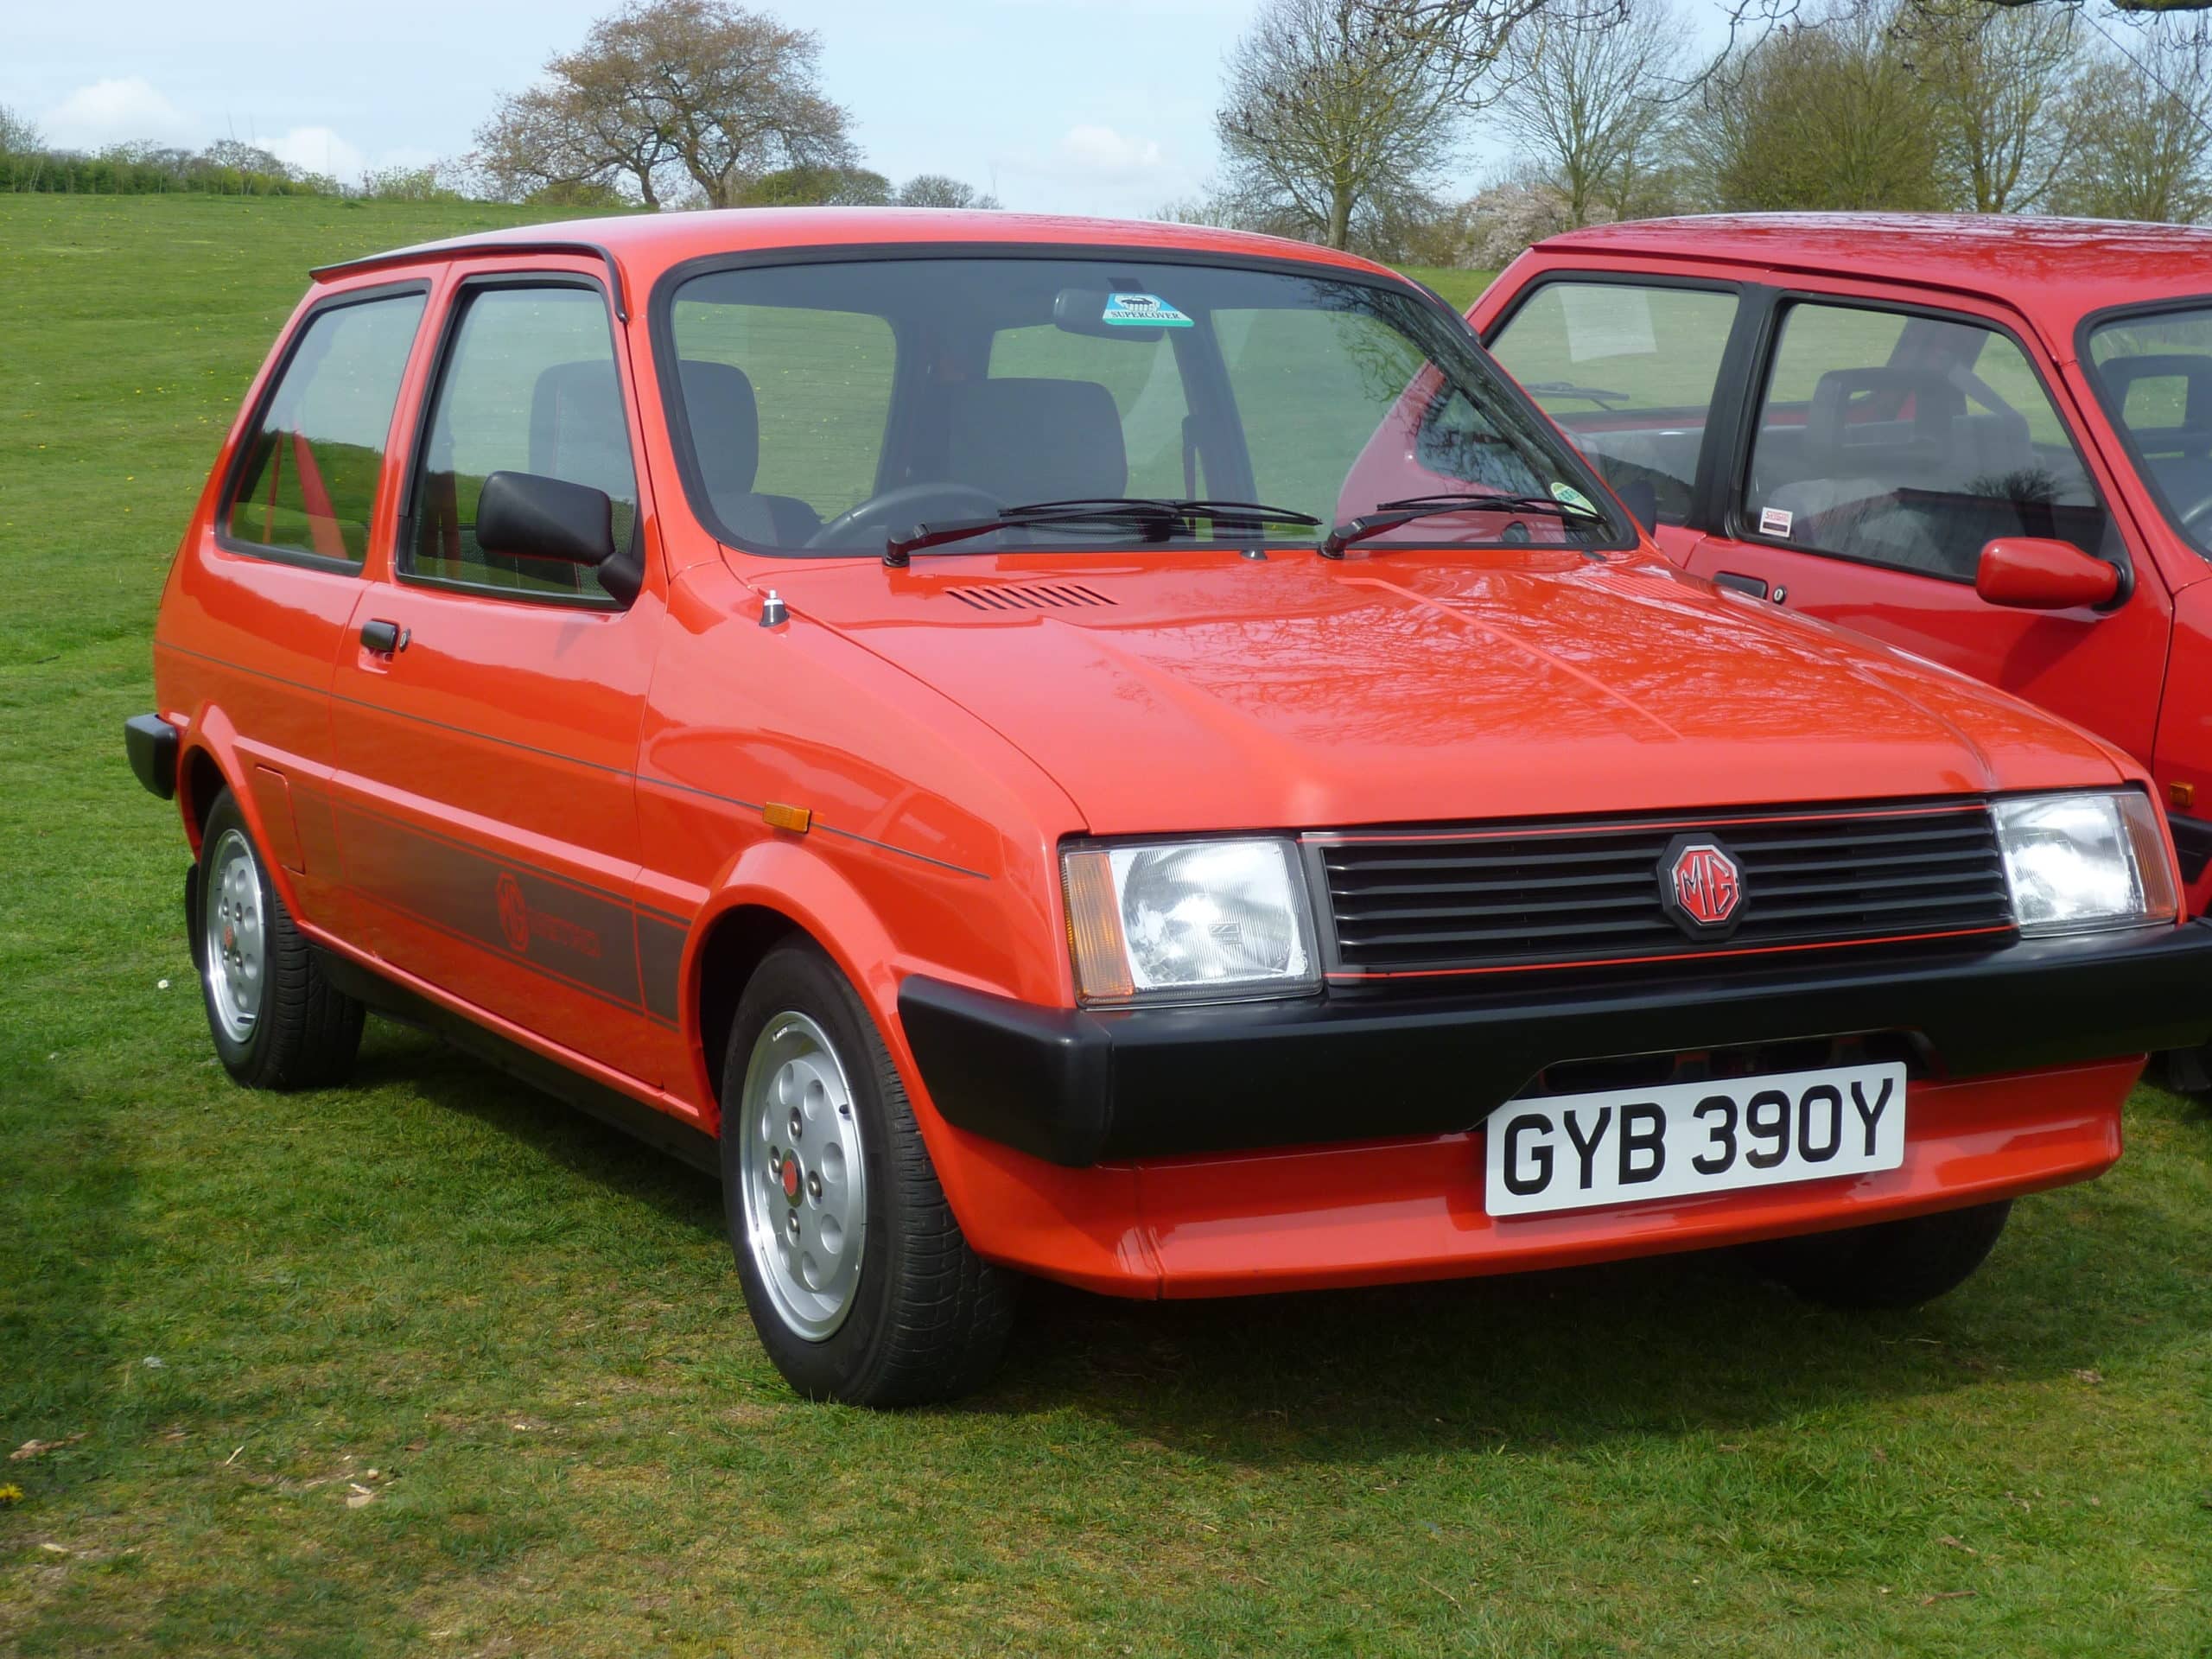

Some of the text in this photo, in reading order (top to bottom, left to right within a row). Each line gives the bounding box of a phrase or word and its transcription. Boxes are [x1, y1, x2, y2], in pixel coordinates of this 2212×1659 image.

[1110, 310, 1180, 320] SUPERCOVER
[500, 878, 527, 946] MG
[1681, 854, 1732, 917] MG
[1503, 1077, 1895, 1197] GYB 390Y
